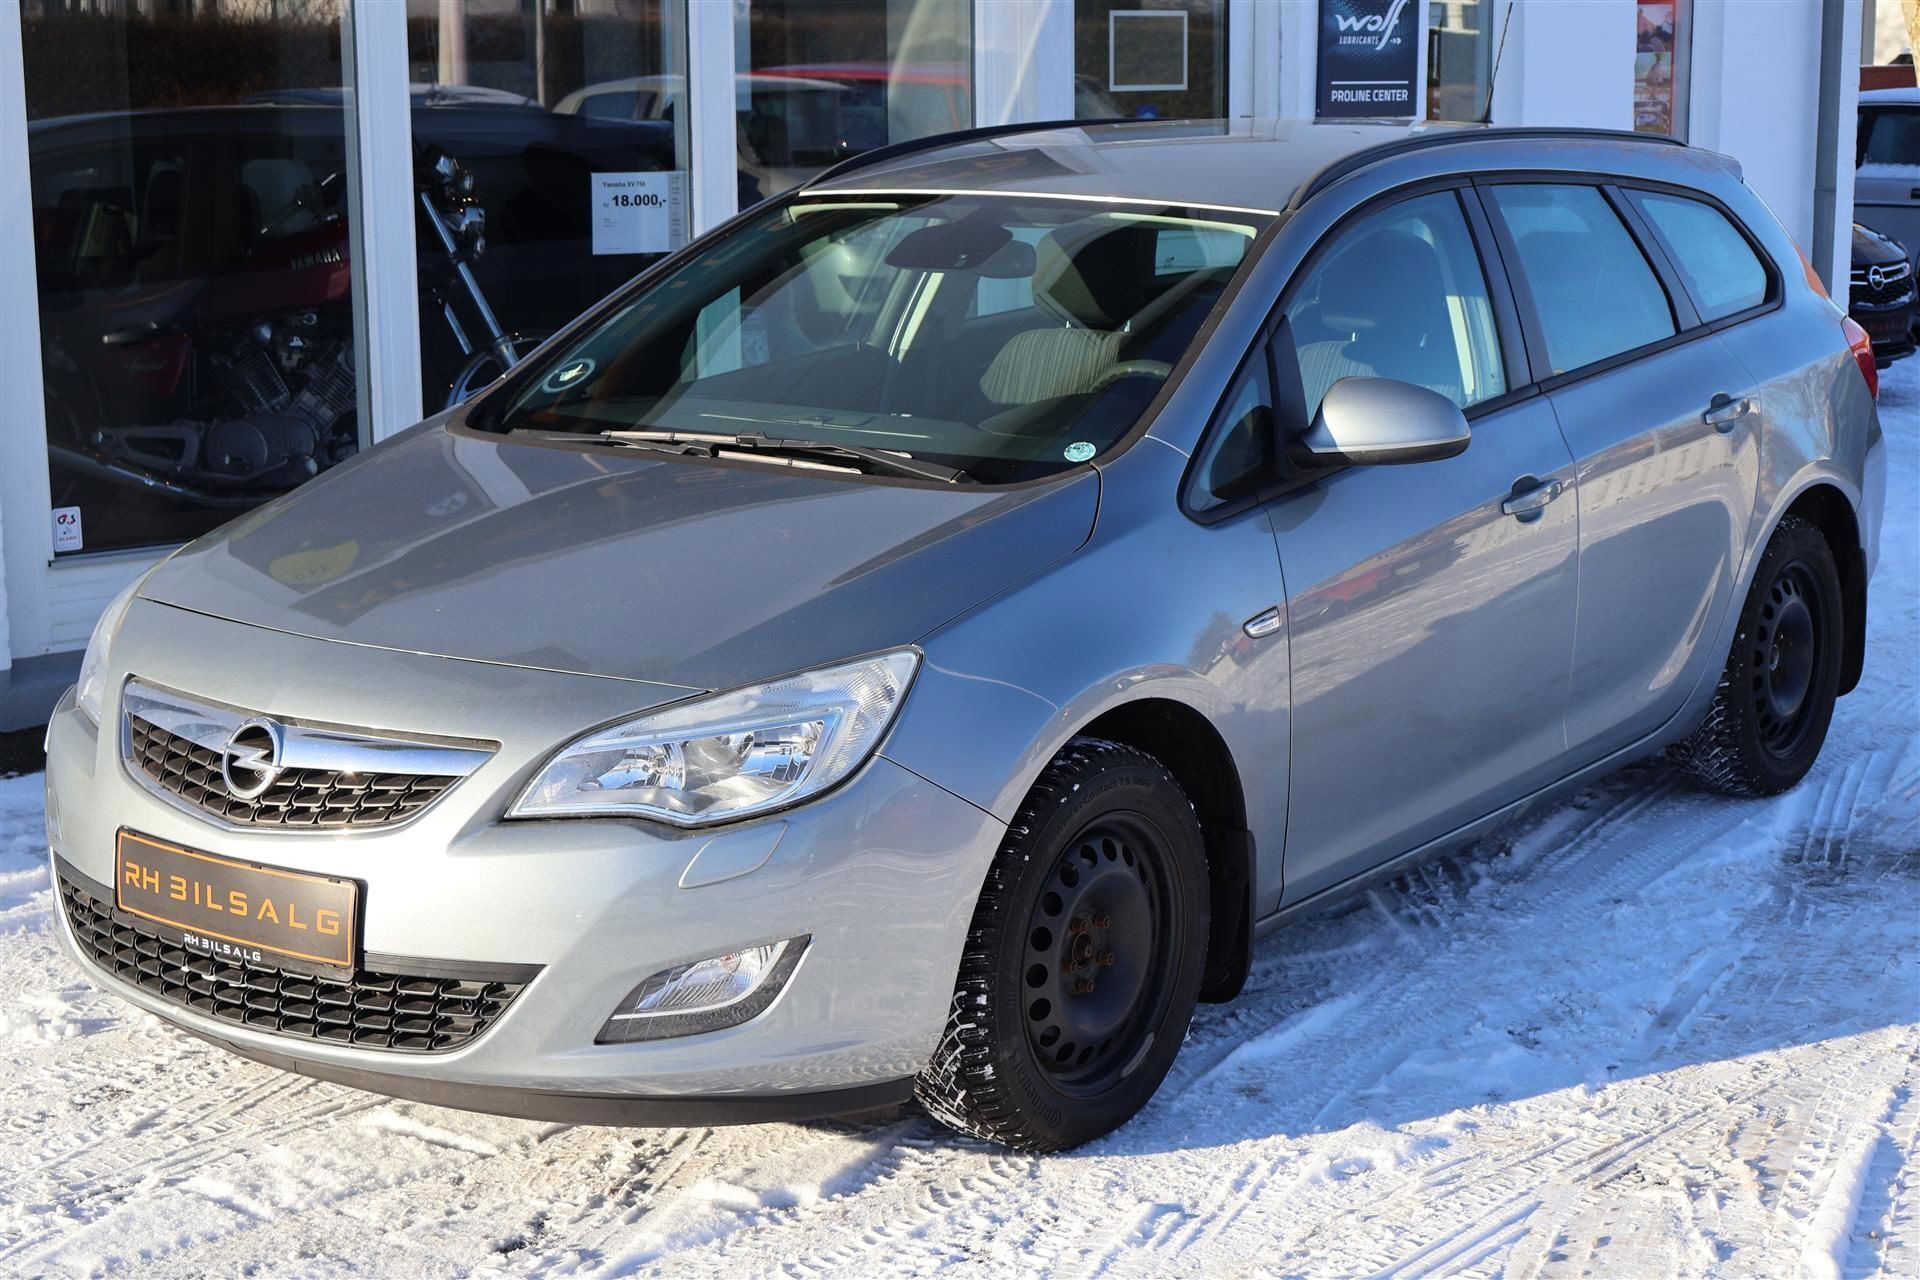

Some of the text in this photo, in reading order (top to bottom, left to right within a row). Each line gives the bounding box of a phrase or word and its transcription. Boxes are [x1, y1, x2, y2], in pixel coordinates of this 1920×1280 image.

[1339, 35, 1379, 45] LUBRICANTS
[1331, 89, 1408, 102] PROLINE CENTER
[612, 193, 666, 208] 18.000,-
[289, 249, 341, 270] YAMAHA
[125, 860, 340, 936] RH BILSALG
[183, 932, 262, 962] RH BILSALG
